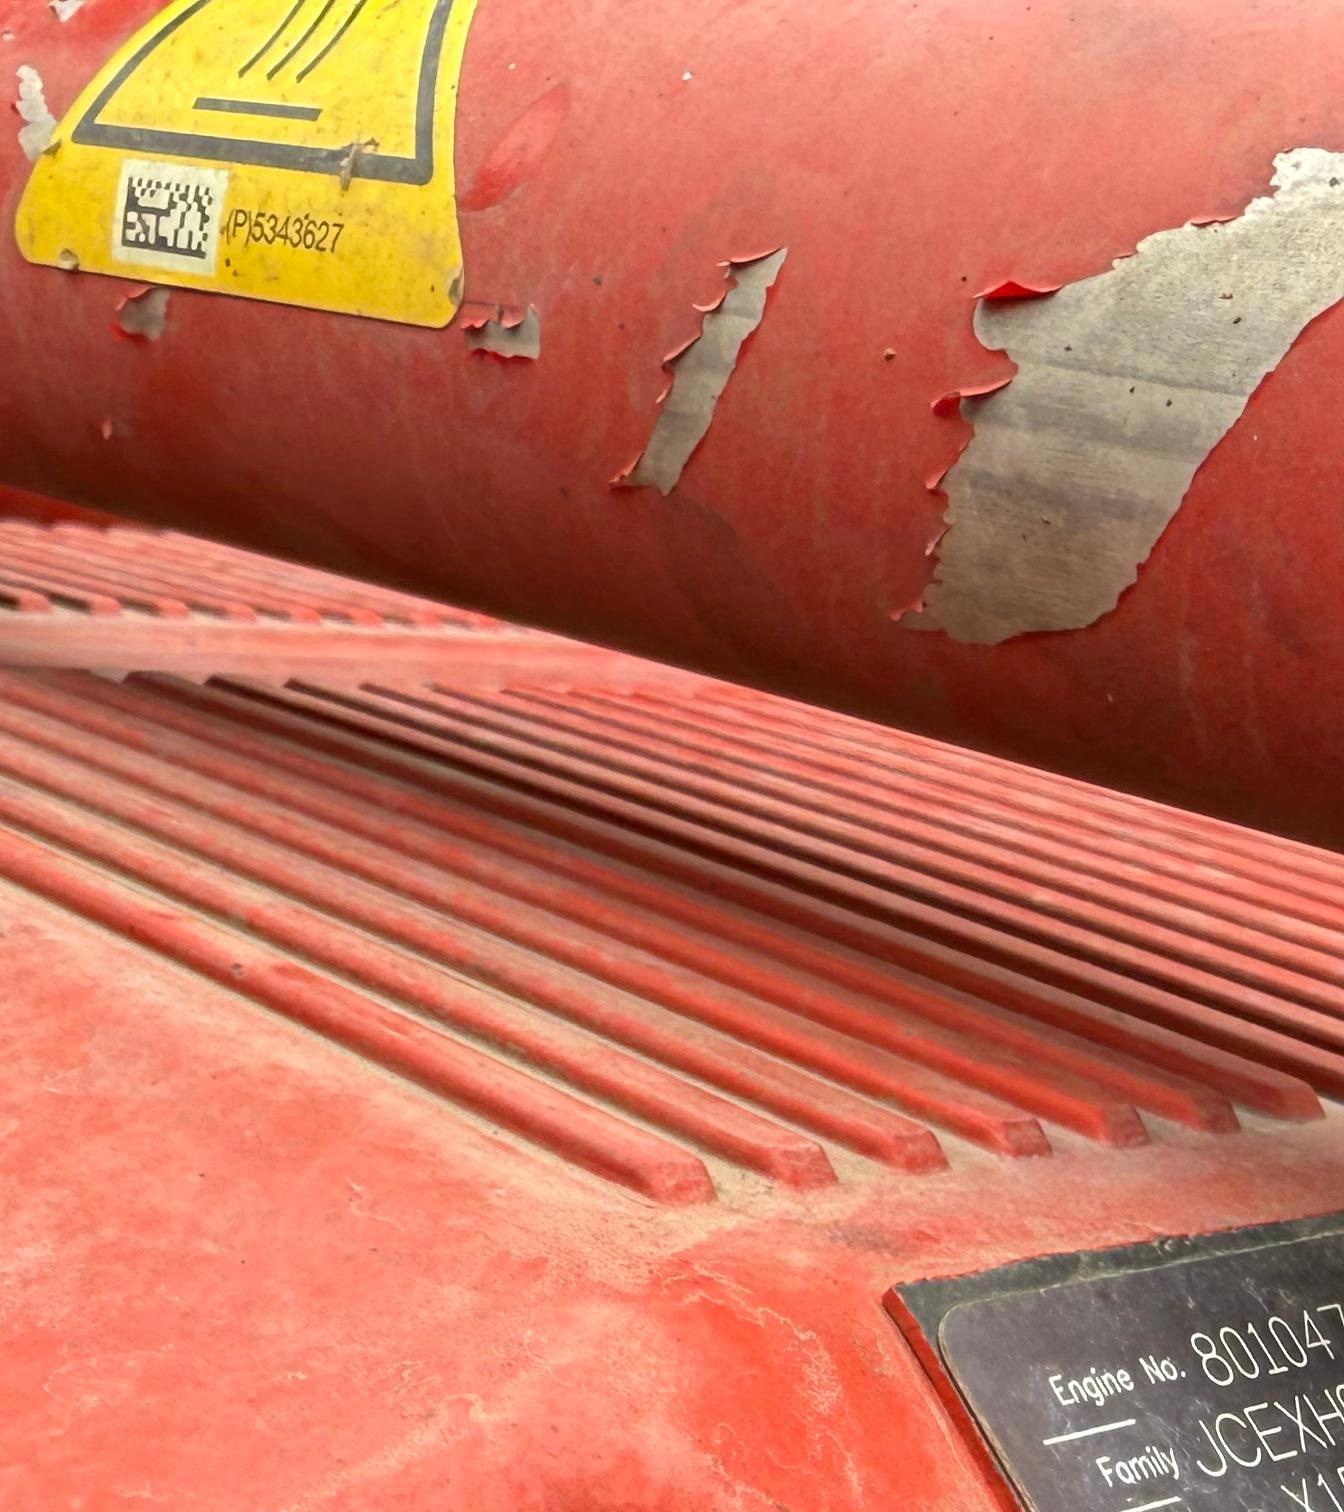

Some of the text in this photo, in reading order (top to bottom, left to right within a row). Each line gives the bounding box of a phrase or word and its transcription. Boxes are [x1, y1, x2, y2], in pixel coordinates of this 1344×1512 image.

[225, 208, 345, 254] (P)5343627
[1048, 1367, 1135, 1406] Engine
[1139, 1355, 1187, 1385] No.
[1095, 1446, 1180, 1488] Family
